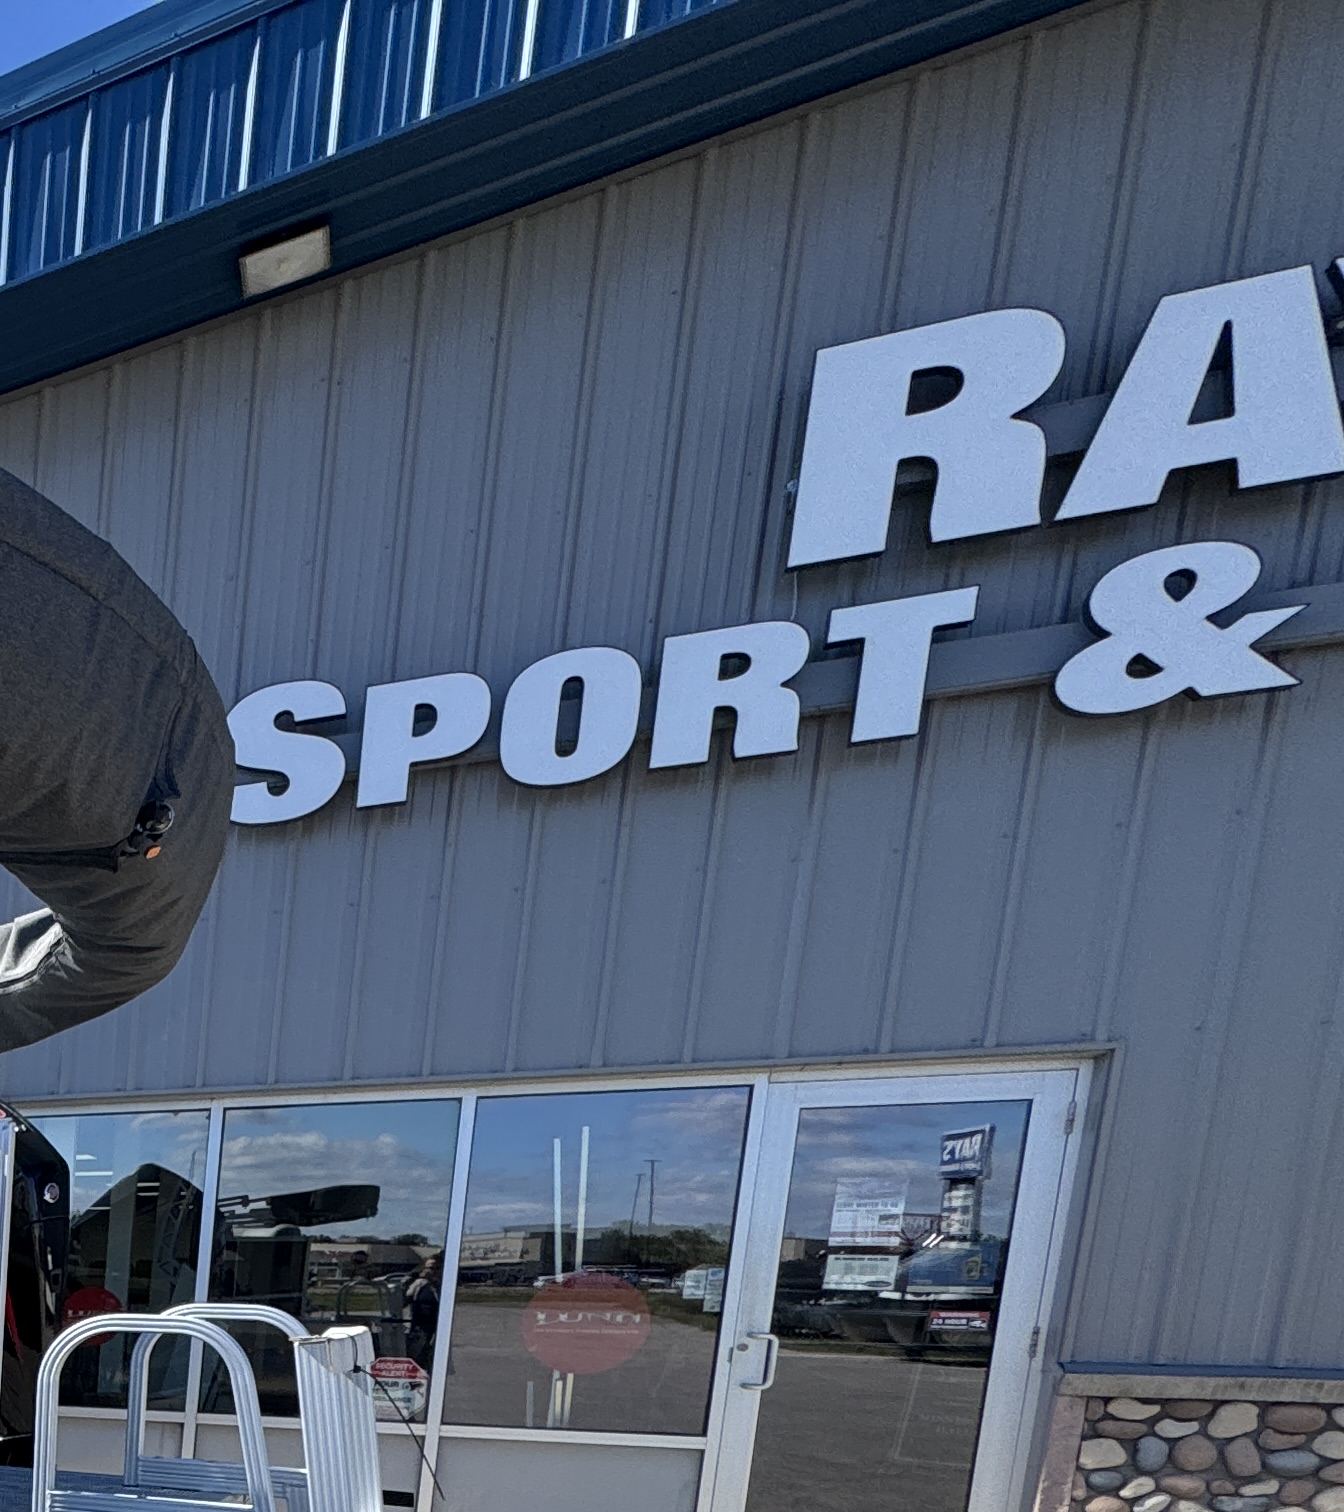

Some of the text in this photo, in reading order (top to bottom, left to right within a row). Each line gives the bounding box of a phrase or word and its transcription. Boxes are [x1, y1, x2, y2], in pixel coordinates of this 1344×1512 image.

[787, 256, 1344, 570] RA
[226, 541, 1310, 825] SPORT &
